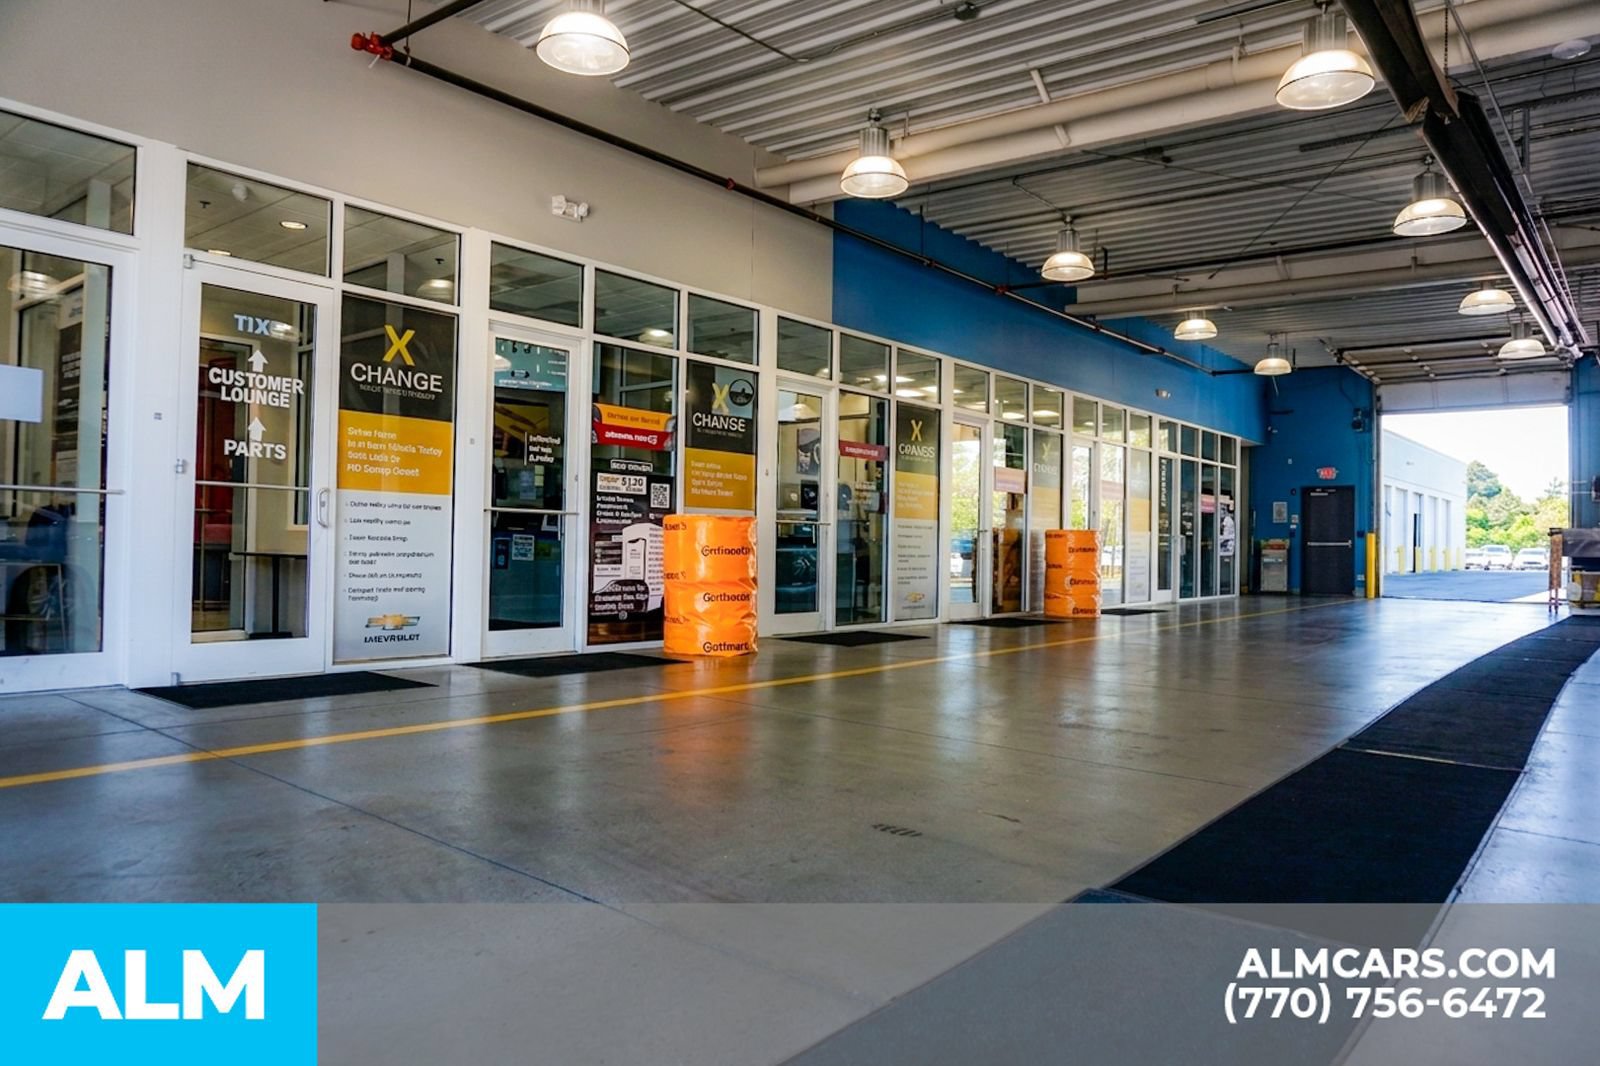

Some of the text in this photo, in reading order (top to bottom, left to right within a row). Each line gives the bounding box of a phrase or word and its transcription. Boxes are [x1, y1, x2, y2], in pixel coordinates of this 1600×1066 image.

[383, 324, 416, 366] X
[208, 367, 304, 395] CUSTOMER
[350, 362, 443, 393] CHANGE
[221, 385, 290, 408] LOUNGE
[712, 383, 729, 416] X
[910, 419, 923, 441] X
[224, 439, 287, 460] PARTS
